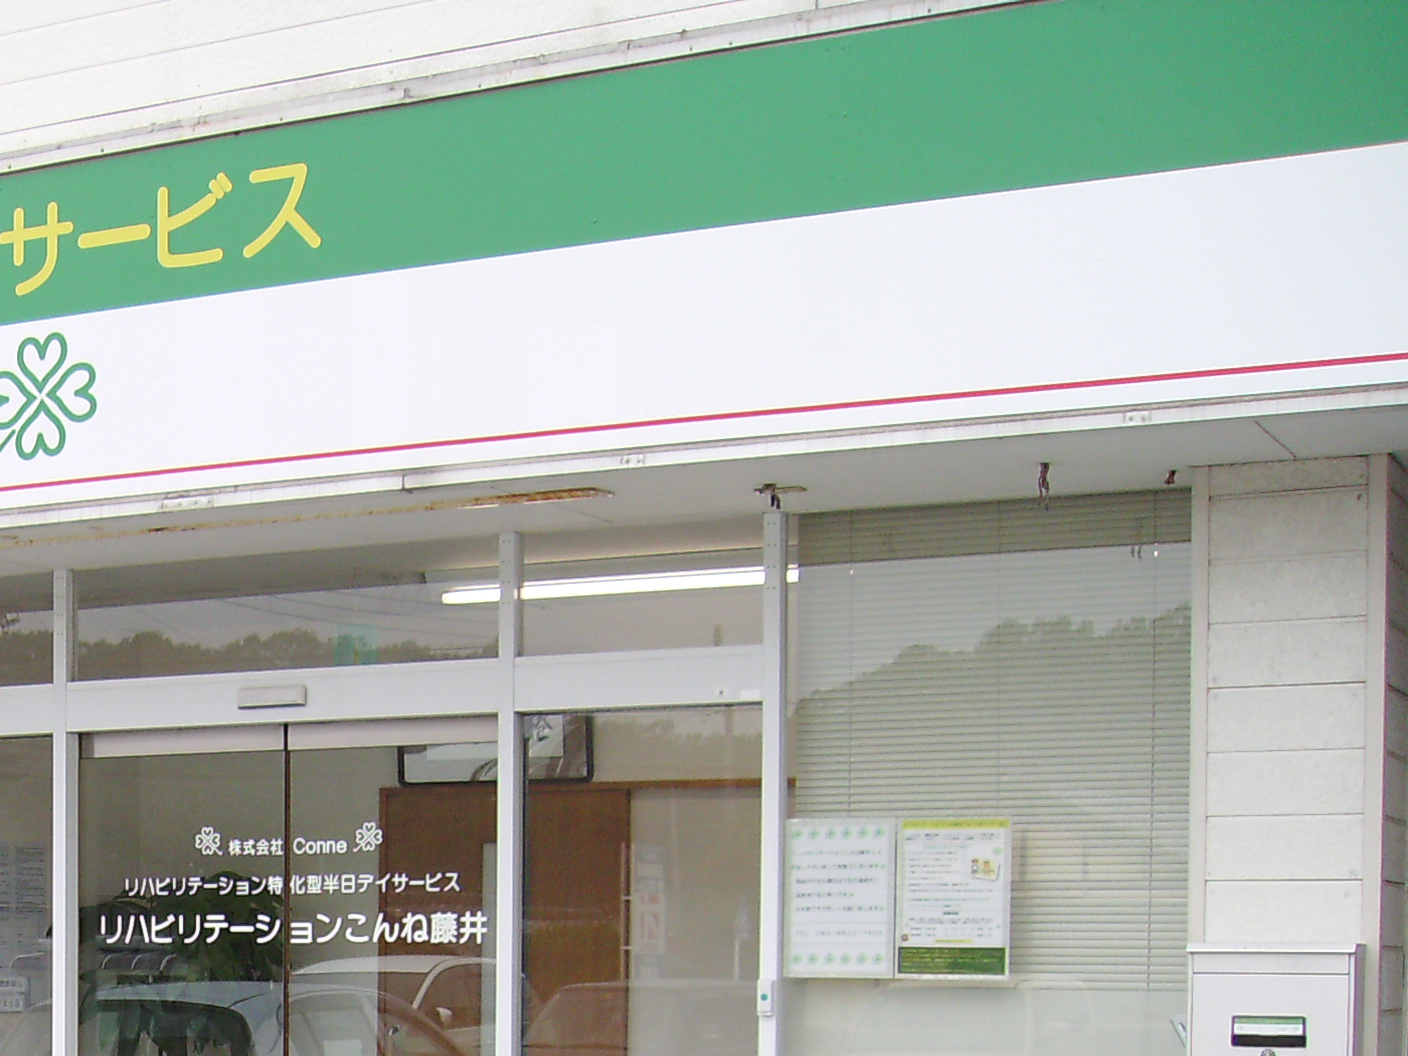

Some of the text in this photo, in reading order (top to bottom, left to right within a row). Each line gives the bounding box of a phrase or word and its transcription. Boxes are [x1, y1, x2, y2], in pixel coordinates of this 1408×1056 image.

[228, 838, 347, 856] 株式会社 Conne
